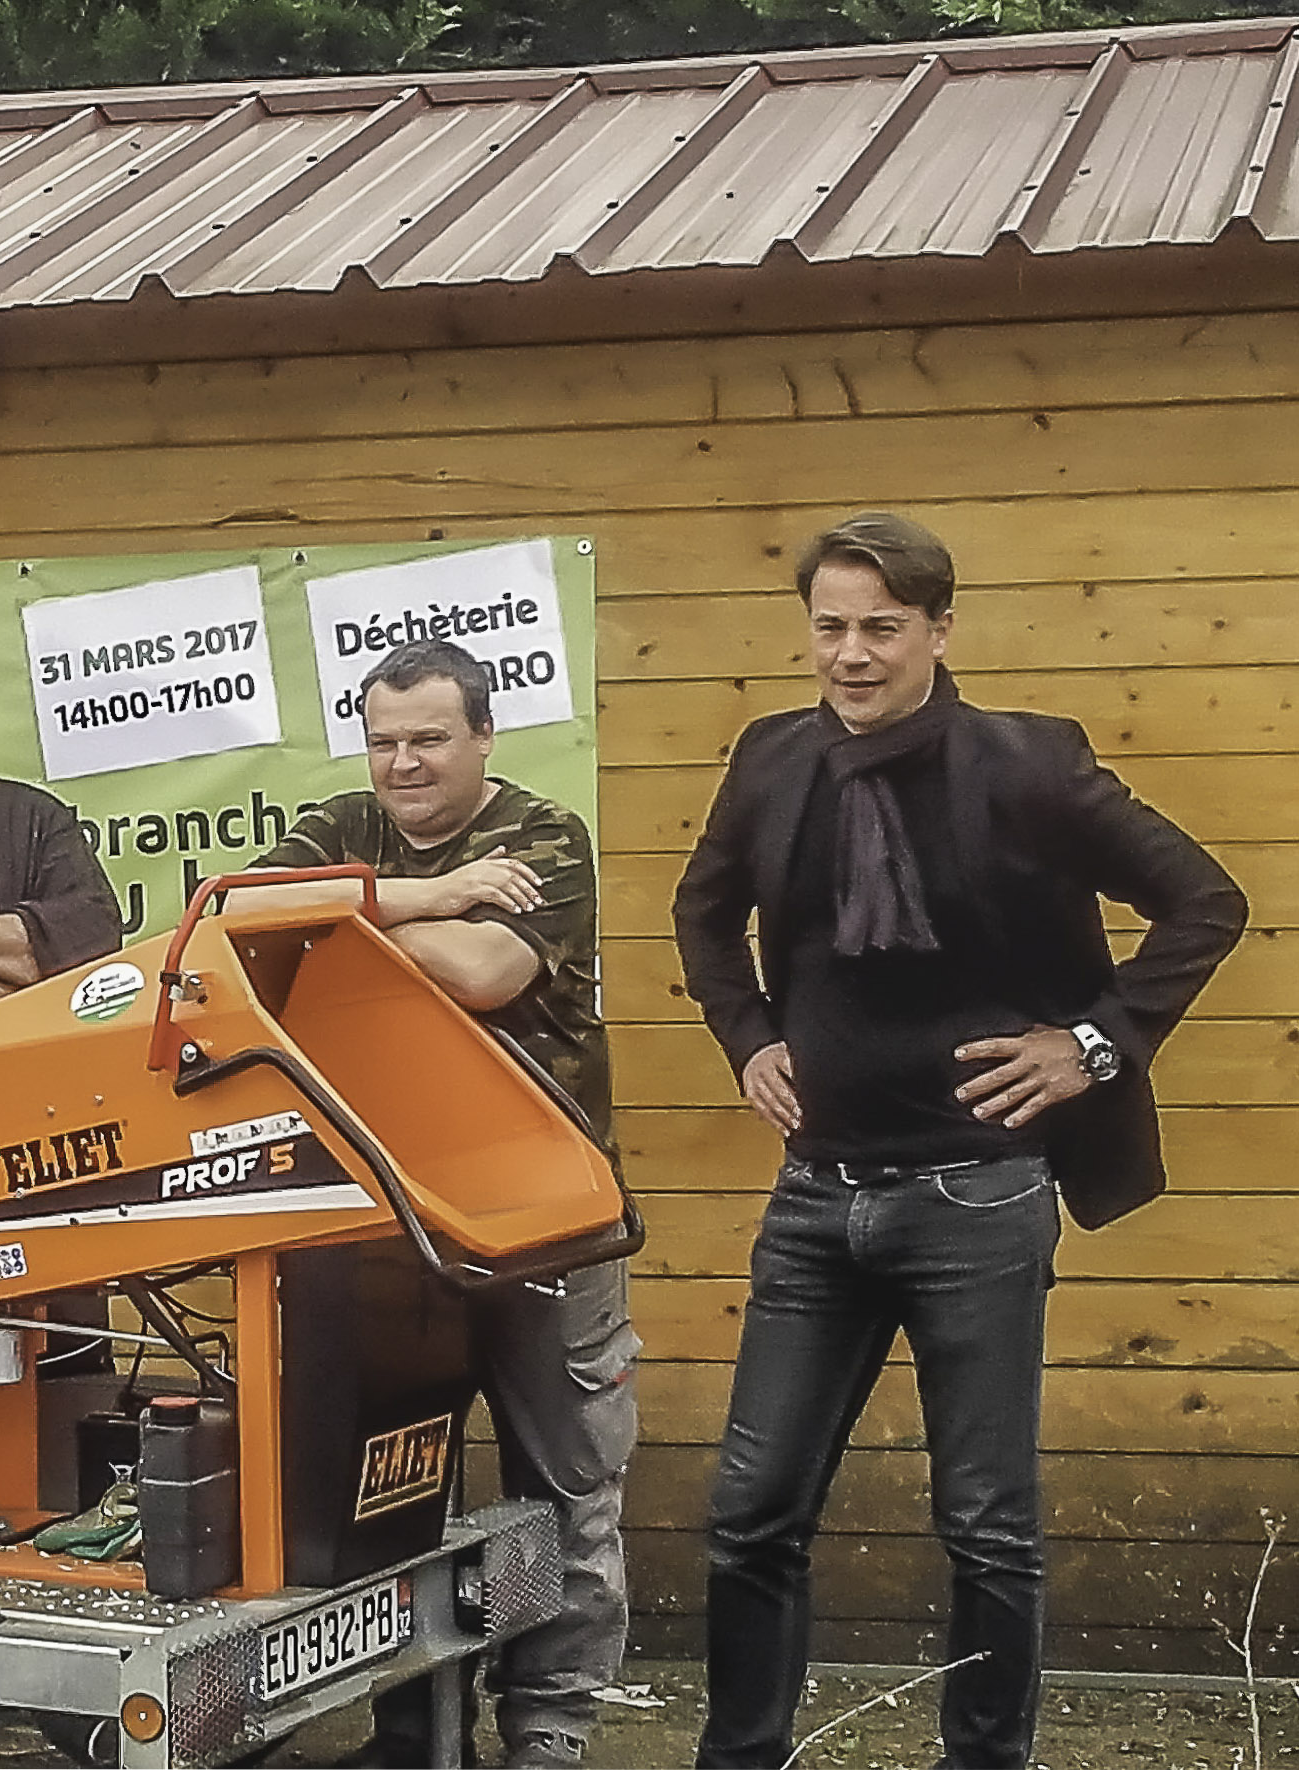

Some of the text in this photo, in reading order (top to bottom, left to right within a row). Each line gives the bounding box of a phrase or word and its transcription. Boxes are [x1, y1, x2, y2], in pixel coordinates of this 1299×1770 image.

[39, 620, 257, 684] 31 MARS 2017
[335, 592, 538, 657] Déchèterie
[54, 673, 255, 732] 14h00-17h00
[0, 1121, 123, 1193] ELIET
[162, 1142, 295, 1198] PROF 5
